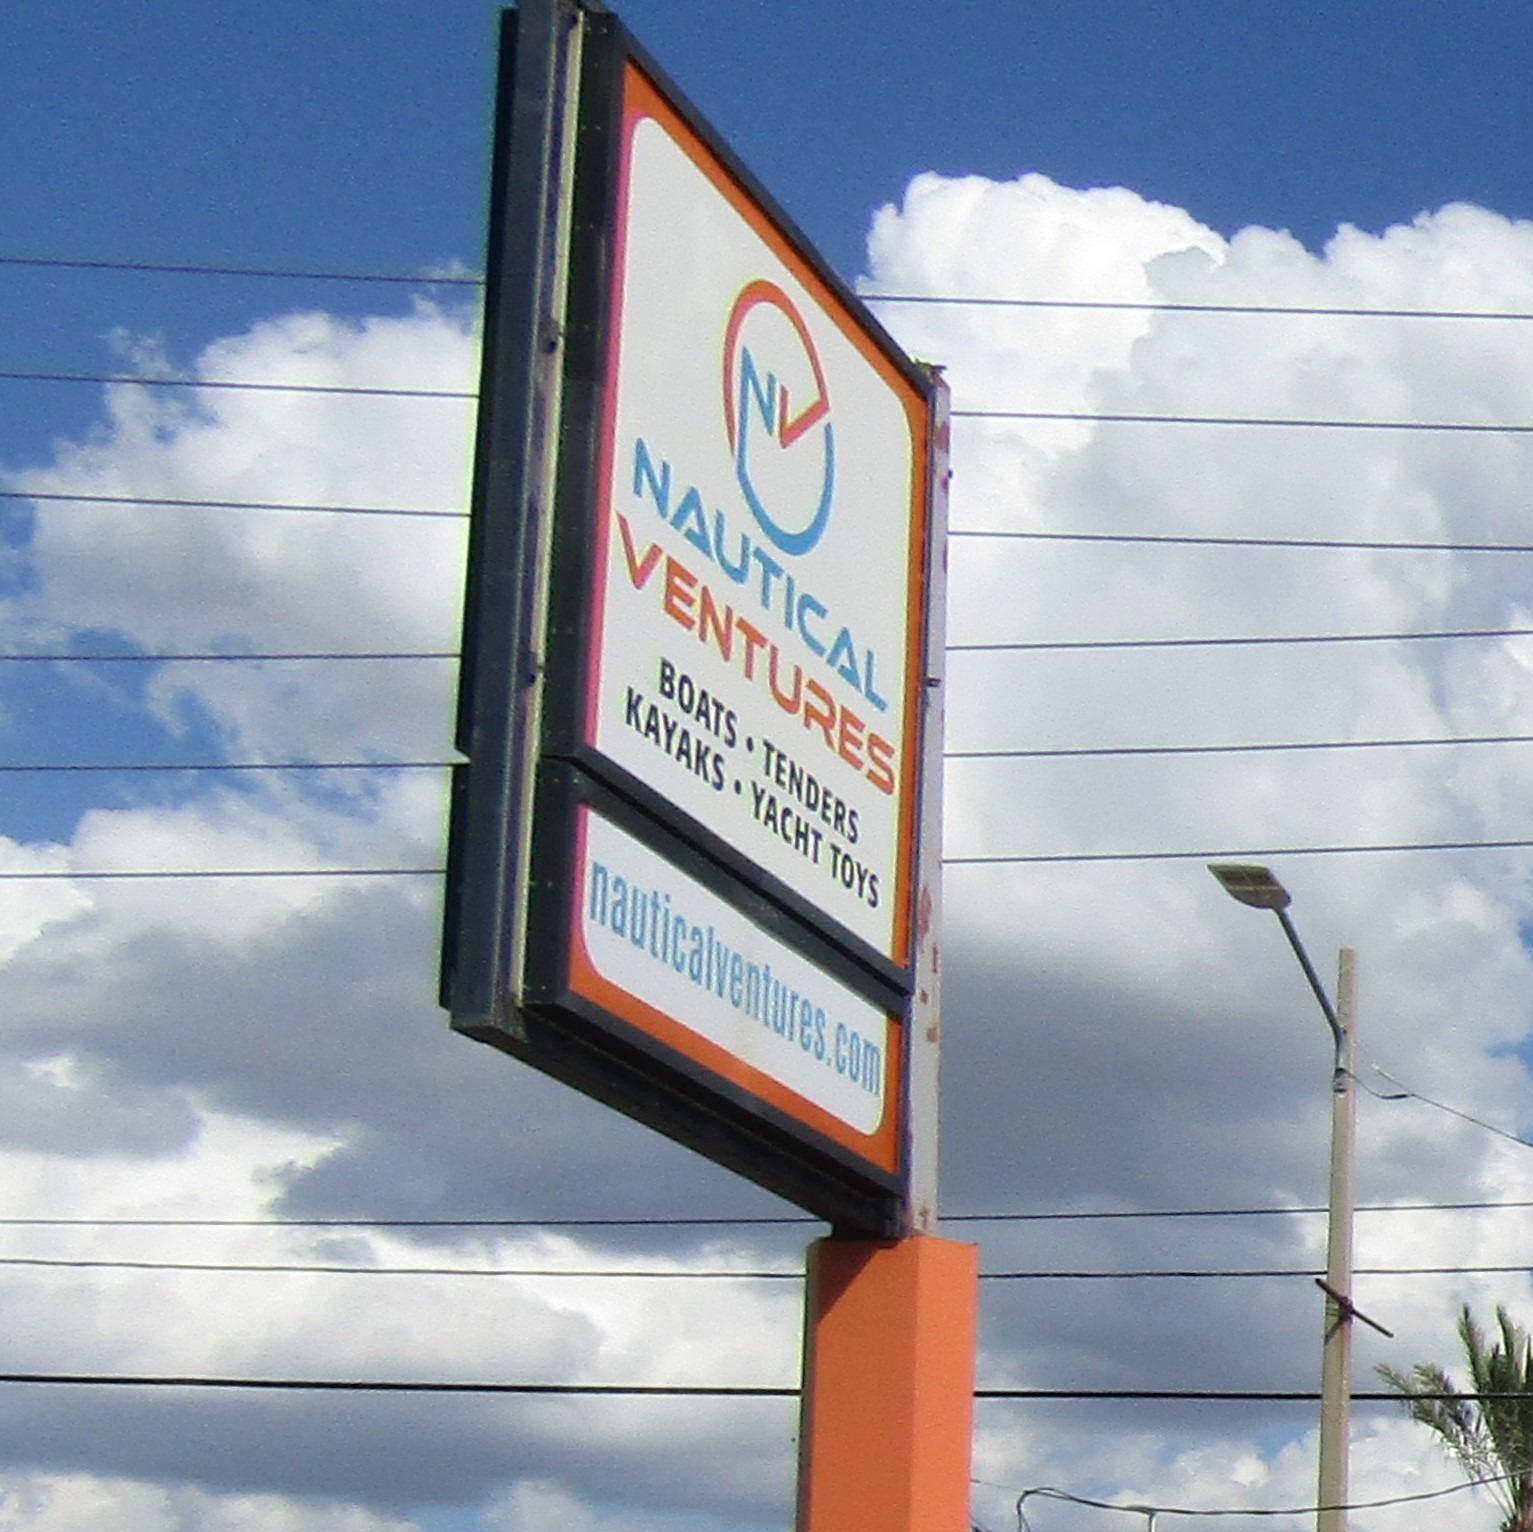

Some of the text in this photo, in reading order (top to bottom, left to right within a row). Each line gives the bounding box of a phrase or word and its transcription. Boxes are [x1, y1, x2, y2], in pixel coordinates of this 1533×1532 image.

[616, 509, 896, 796] VENTURES
[633, 437, 888, 713] NAUTICAL
[625, 685, 881, 909] KAYAKS YACHT TOYS
[659, 656, 859, 845] BOATS TENDERS
[589, 861, 882, 1097] nauticalventures.com
